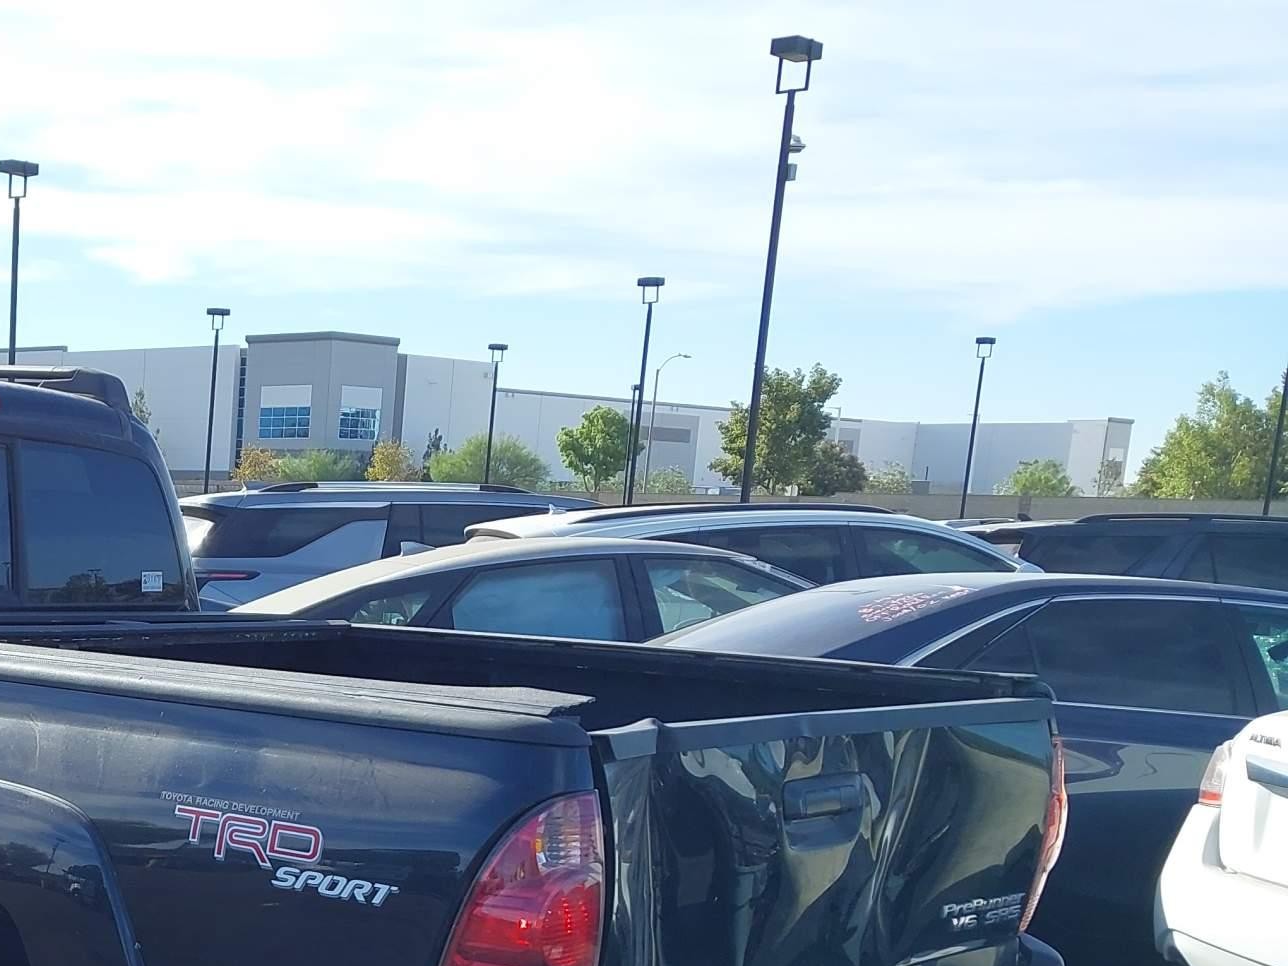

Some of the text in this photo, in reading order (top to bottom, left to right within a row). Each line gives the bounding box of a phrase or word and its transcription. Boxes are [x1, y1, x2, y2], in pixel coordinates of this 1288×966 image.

[161, 790, 301, 821] TOYOTA RACING DEVELOPMENT
[175, 804, 324, 869] TRD
[272, 866, 400, 907] SPORT
[943, 892, 1026, 918] PreRunner
[952, 914, 977, 929] V6
